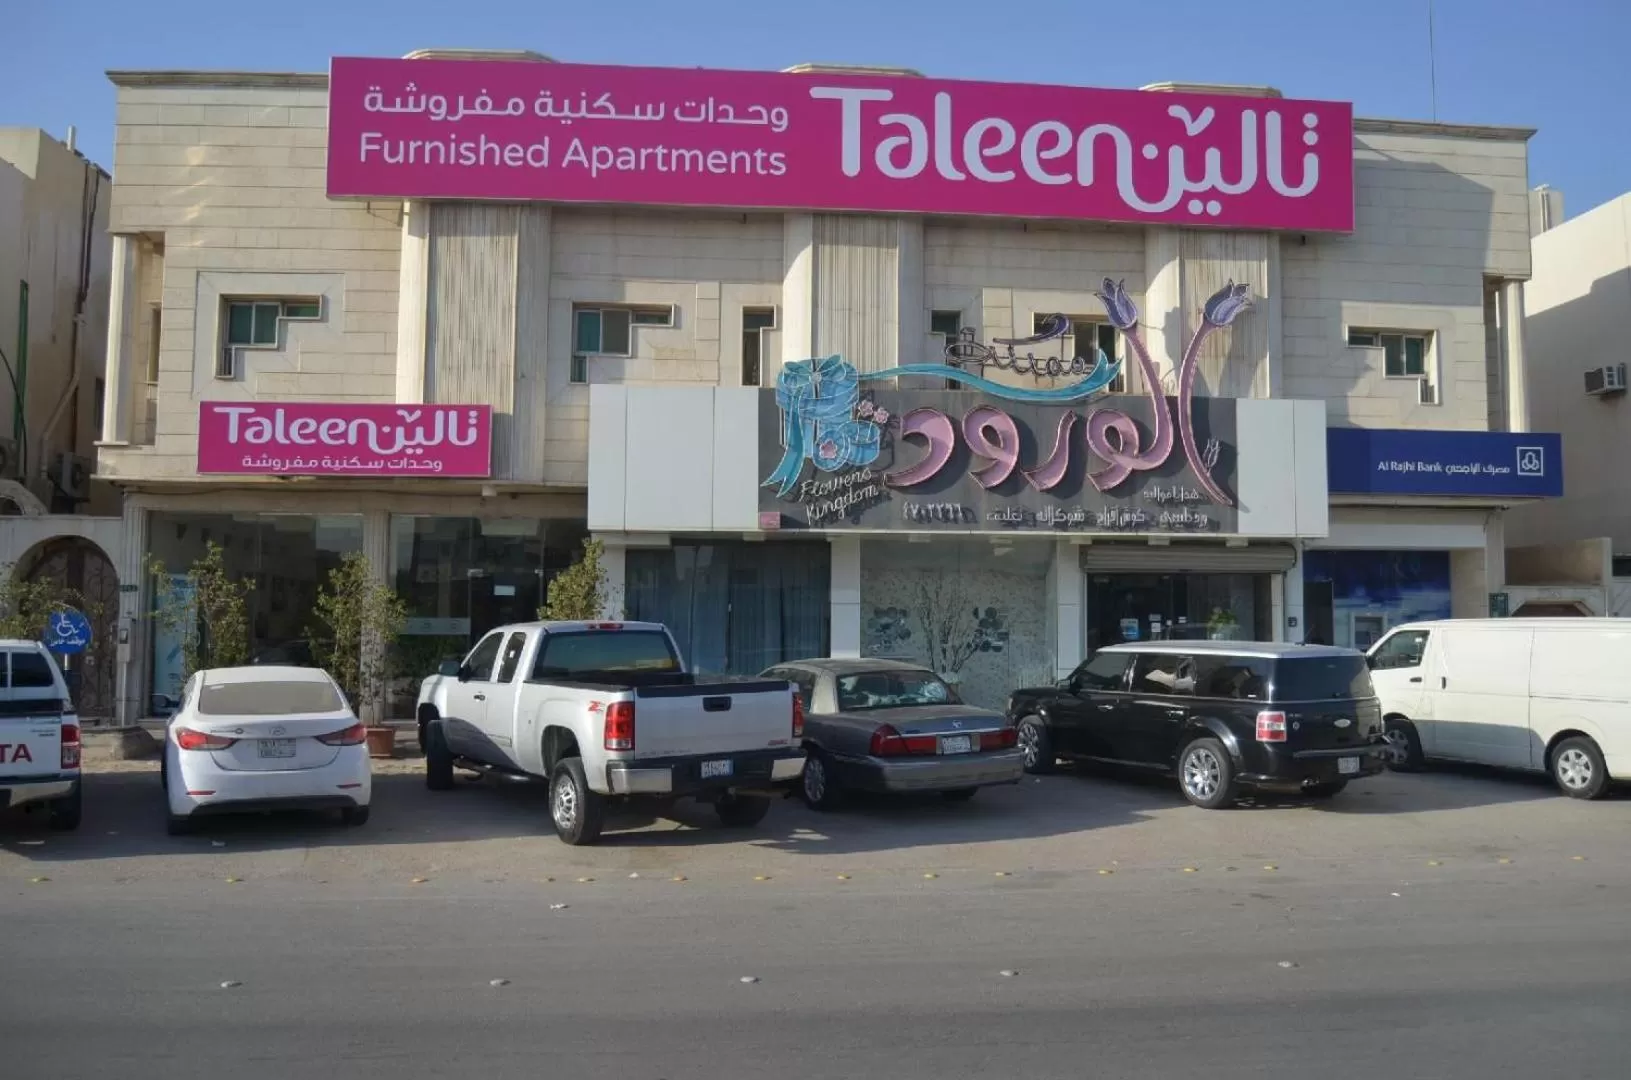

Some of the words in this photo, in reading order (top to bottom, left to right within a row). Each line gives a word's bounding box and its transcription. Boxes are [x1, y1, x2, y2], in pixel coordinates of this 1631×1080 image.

[363, 82, 525, 122] مفروشة
[534, 89, 666, 125] سكنية
[674, 97, 789, 132] وحدات
[809, 86, 1133, 187] Taleen
[360, 131, 550, 168] Furnished
[561, 137, 788, 178] Apartments
[213, 406, 377, 446] Taleen
[242, 453, 318, 471] مفروشة
[322, 456, 385, 471] سكنية
[387, 457, 443, 472] وحدات
[1378, 461, 1389, 471] Al
[1391, 461, 1416, 474] Rajhi
[1417, 462, 1442, 473] Bank
